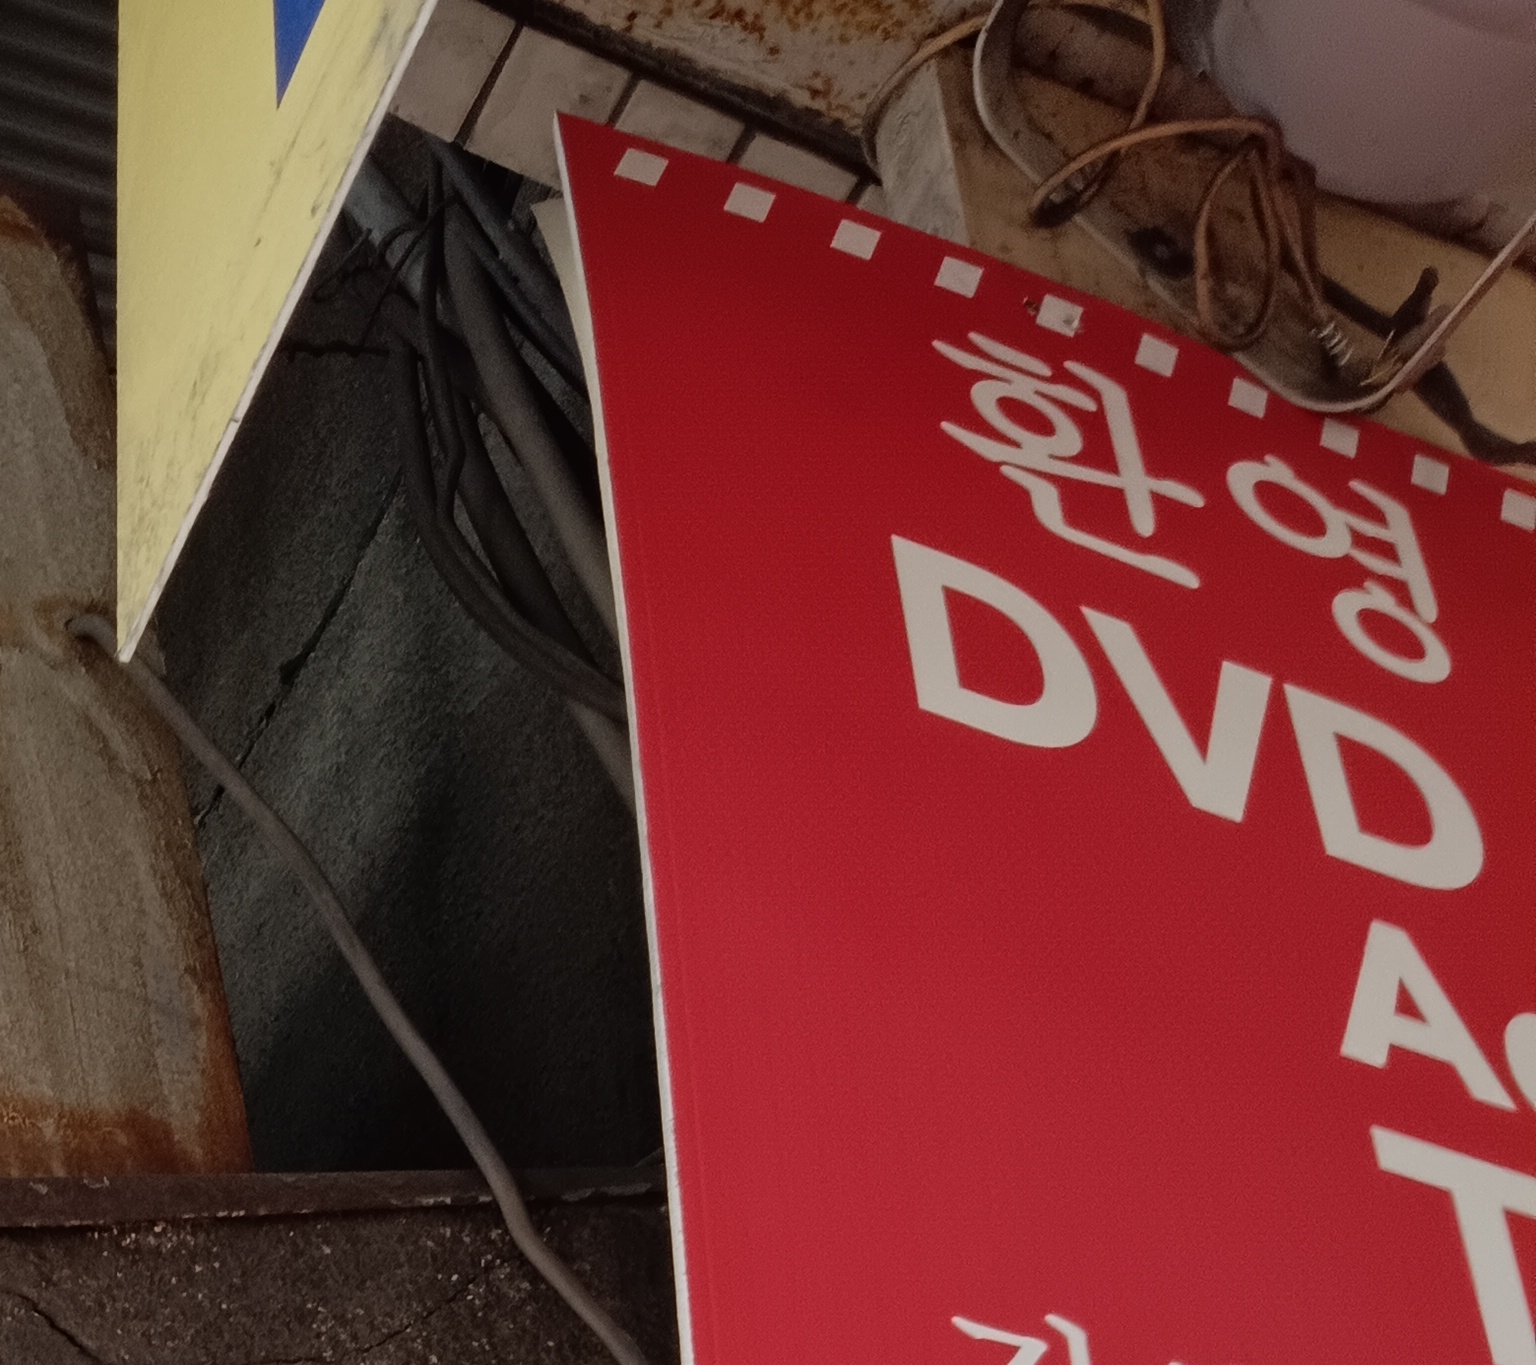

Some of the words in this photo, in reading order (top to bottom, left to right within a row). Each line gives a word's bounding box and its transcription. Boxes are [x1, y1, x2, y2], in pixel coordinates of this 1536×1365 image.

[932, 331, 1453, 684] 환영
[891, 533, 1486, 892] DVD
[1339, 918, 1536, 1114] A
